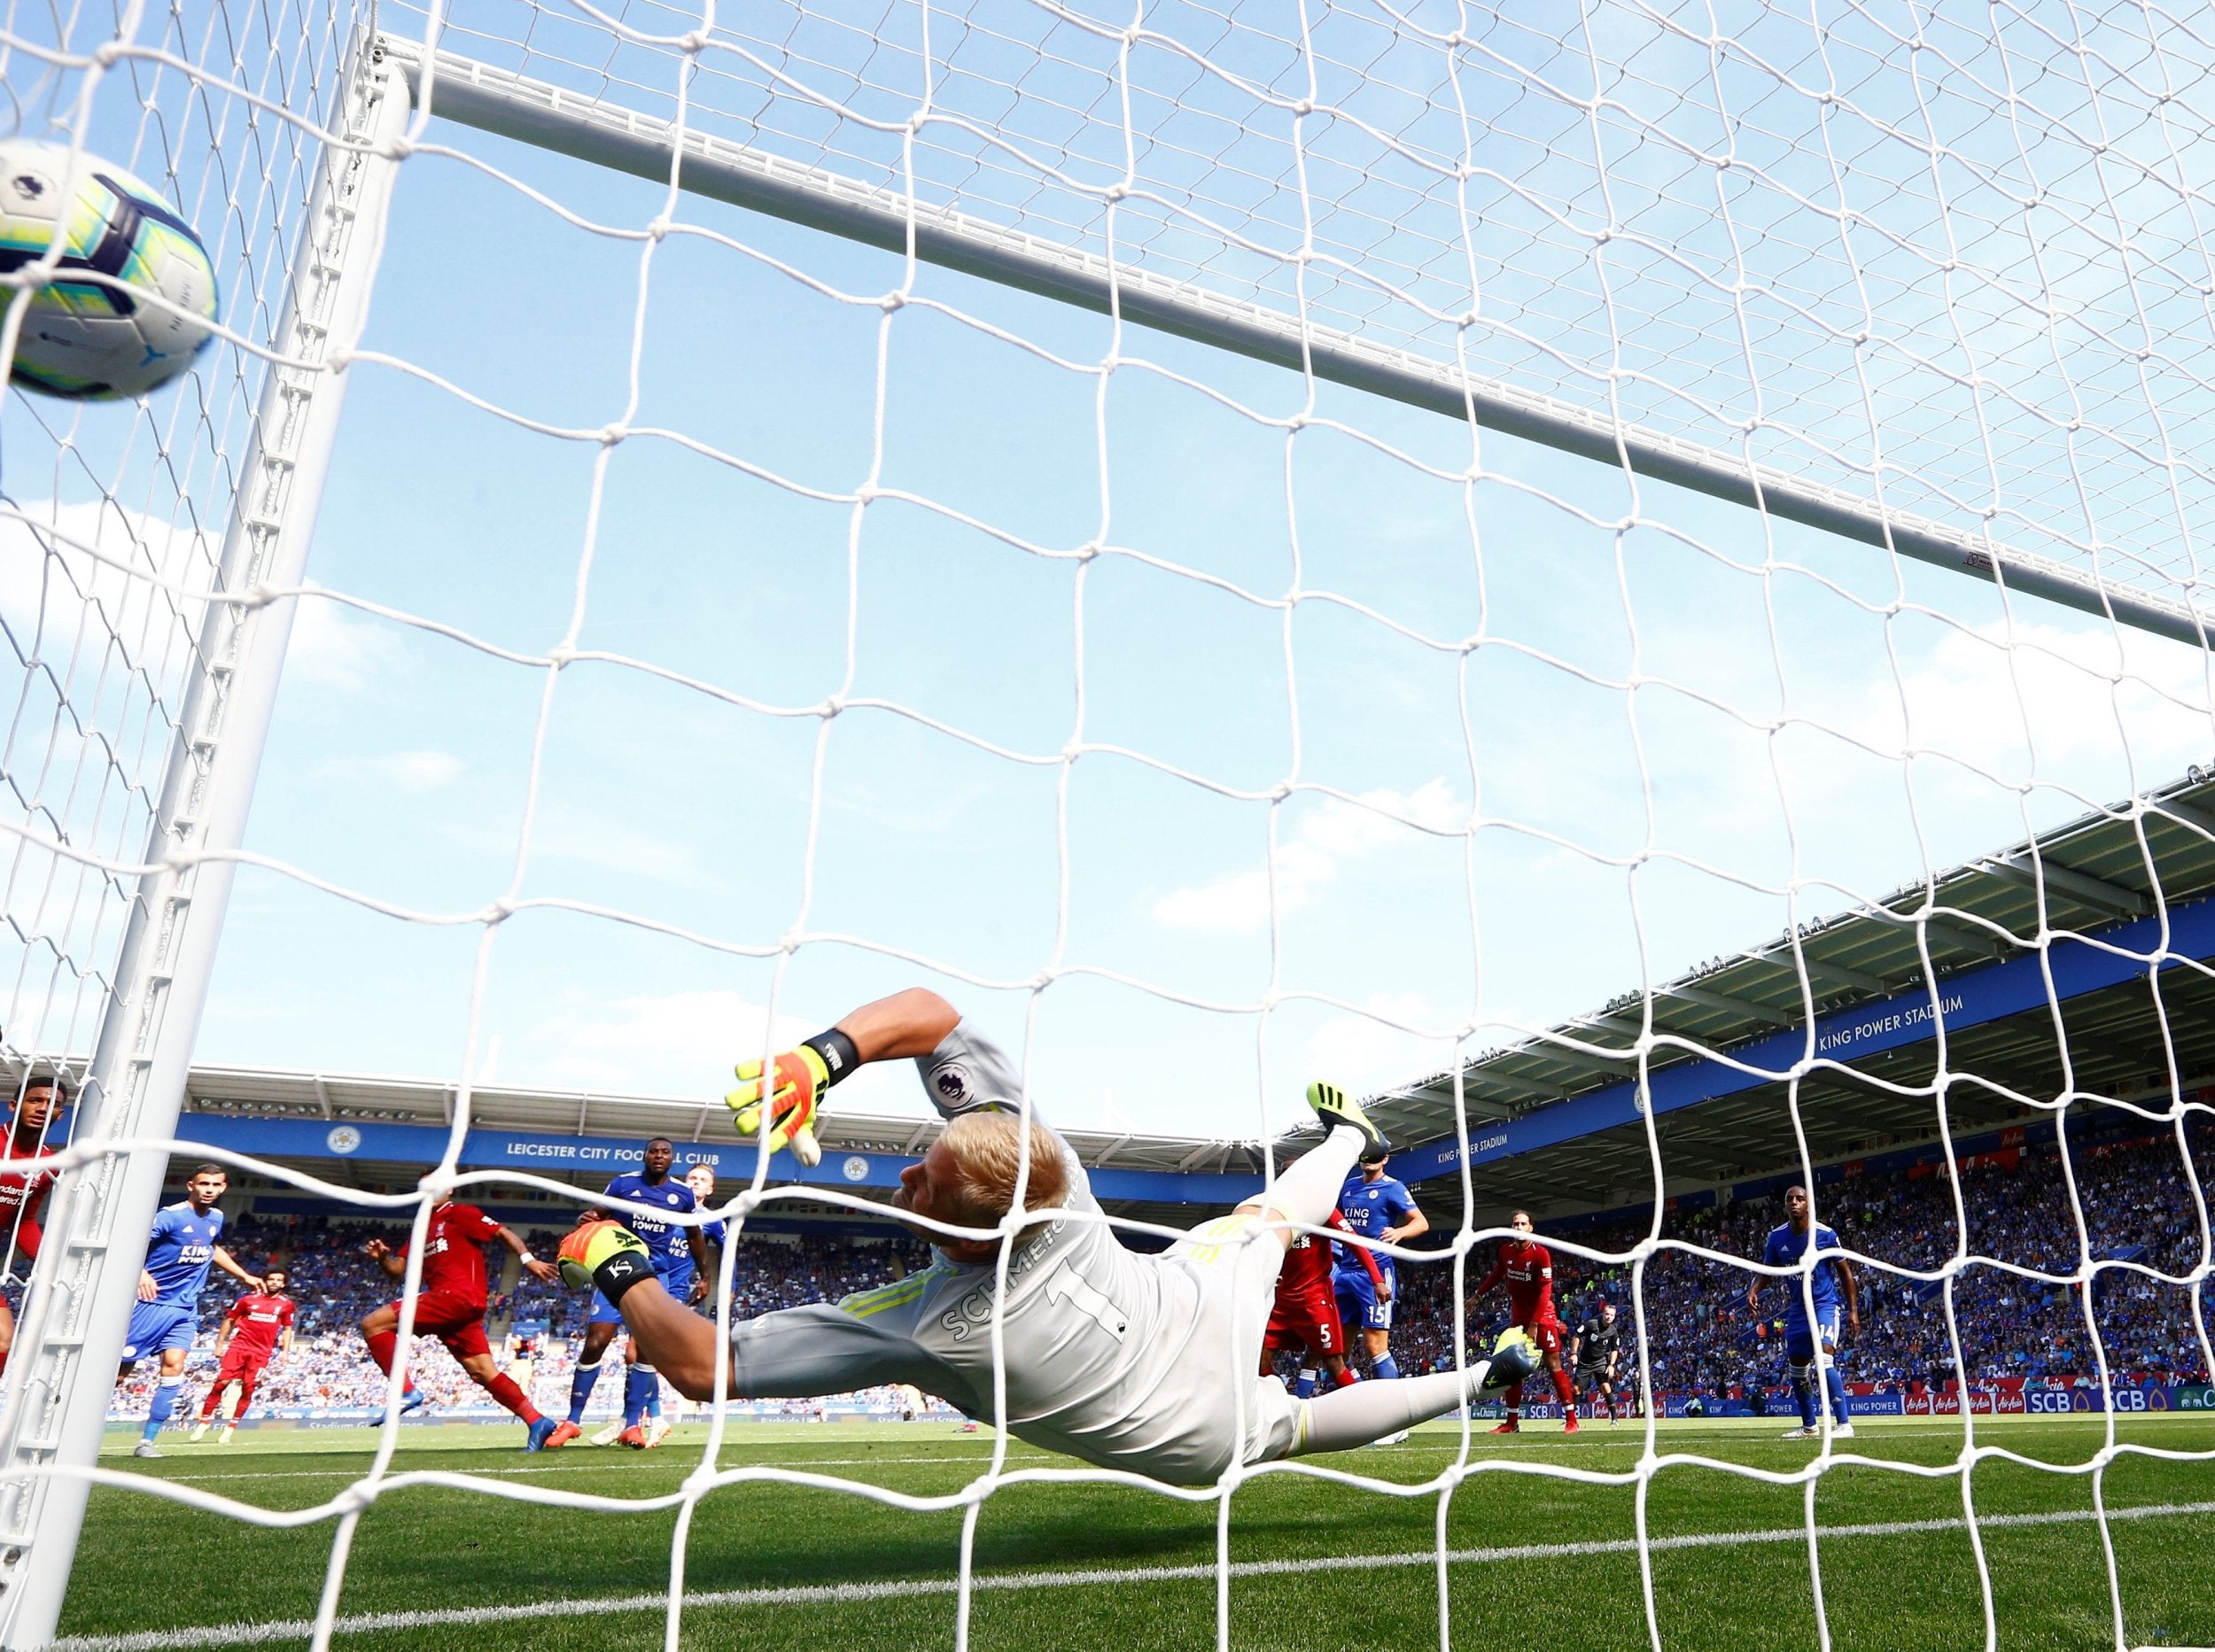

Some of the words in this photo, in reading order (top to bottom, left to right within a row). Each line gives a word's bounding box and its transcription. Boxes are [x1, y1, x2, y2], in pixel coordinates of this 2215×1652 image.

[1819, 1029, 1852, 1051] KING
[1854, 1015, 1901, 1041] POWER
[1905, 995, 1963, 1026] STADUM
[507, 1143, 576, 1158] LEICESTER
[579, 1147, 610, 1160] CITY
[614, 1149, 682, 1163] FOOL
[686, 1152, 719, 1165] CLUB
[1437, 1151, 1455, 1164] KING
[1456, 1143, 1479, 1159] PER
[1480, 1133, 1508, 1152] STADIUM
[1344, 1208, 1370, 1219] KING
[1346, 1218, 1368, 1228] OWER
[670, 1237, 689, 1250] NG
[1368, 1305, 1385, 1323] 15
[1320, 1323, 1331, 1343] 5
[1546, 1330, 1555, 1343] 4
[1819, 1323, 1835, 1342] 14
[1770, 1404, 1792, 1413] POWER
[1850, 1402, 1869, 1411] KING
[1870, 1401, 1898, 1411] POWER
[1935, 1397, 1958, 1412] AirAsia
[1997, 1395, 2023, 1412] AirAsia
[2031, 1392, 2071, 1413] SCB
[1480, 1407, 1497, 1419] Chang
[1530, 1405, 1548, 1419] SCB
[1561, 1405, 1581, 1419] SB
